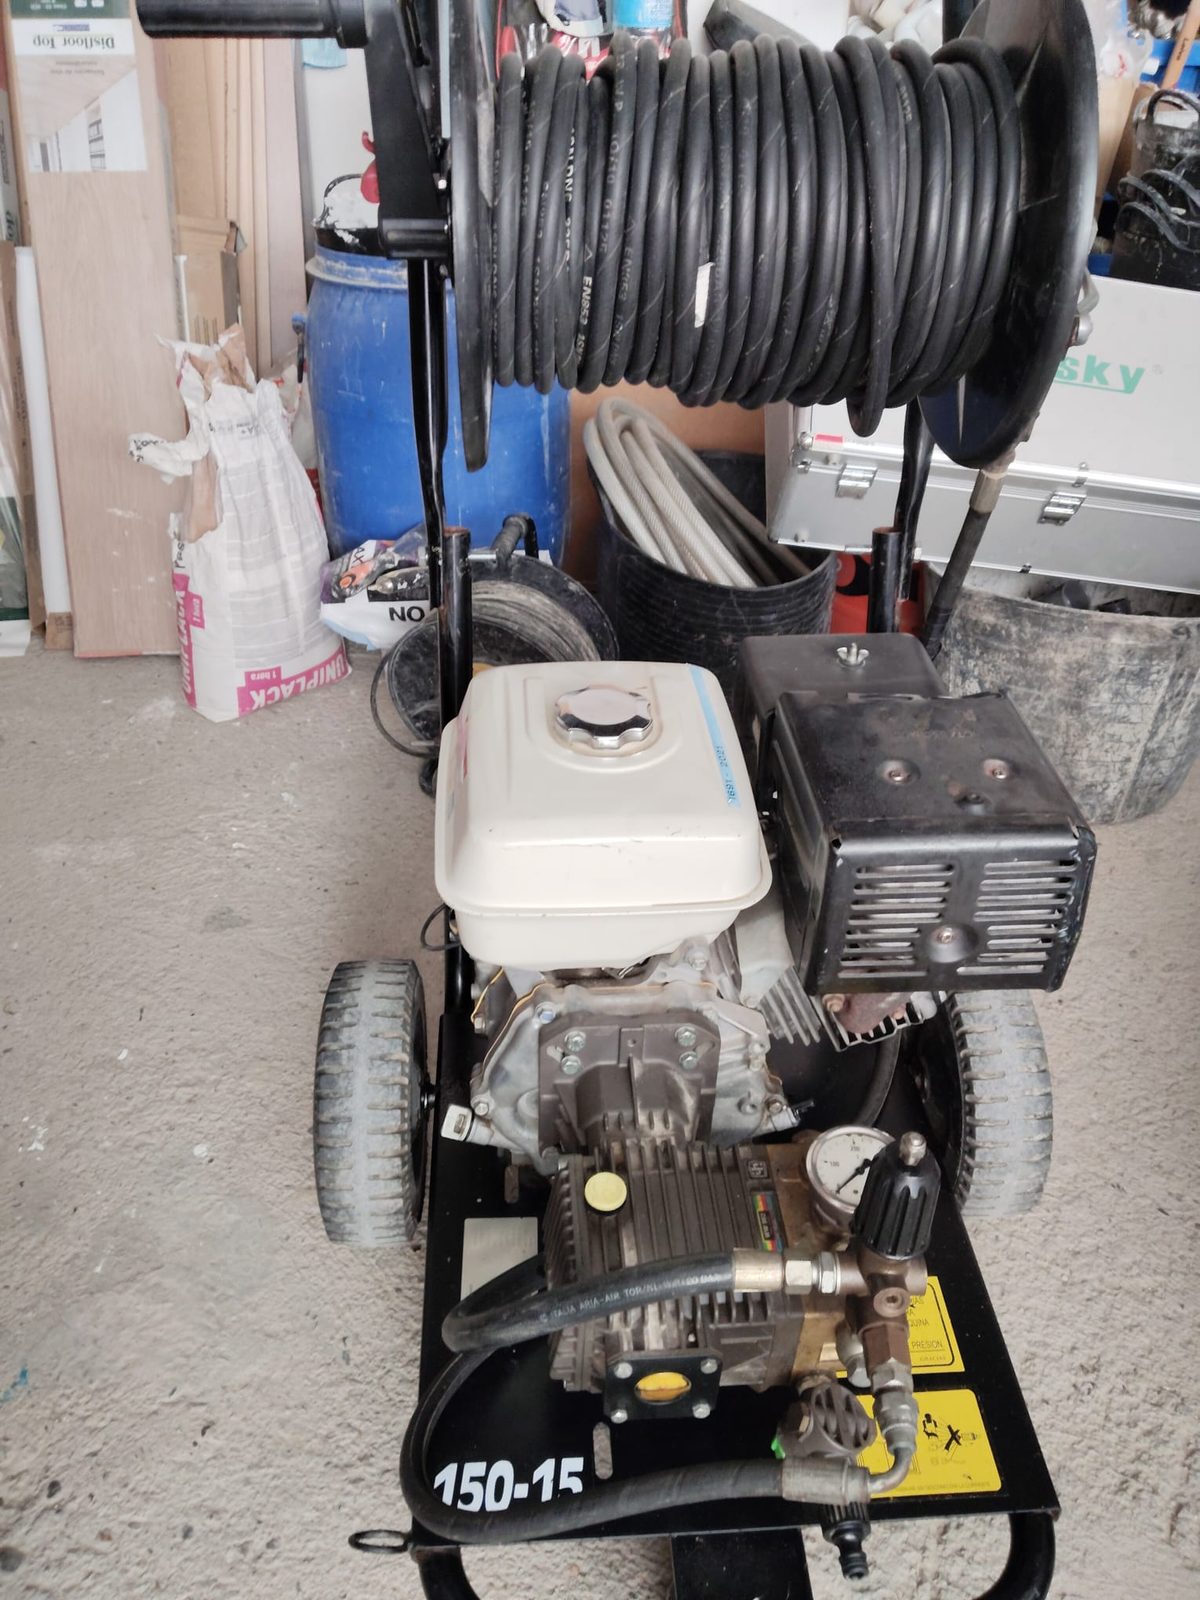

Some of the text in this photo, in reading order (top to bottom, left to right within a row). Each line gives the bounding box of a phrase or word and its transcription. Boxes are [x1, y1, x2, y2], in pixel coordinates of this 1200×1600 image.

[32, 34, 115, 49] Disfloor Top
[579, 275, 593, 326] EN853
[388, 605, 427, 623] NO
[249, 653, 346, 711] UNIPLACK
[272, 670, 278, 680] 1
[433, 1457, 585, 1512] 150-15
